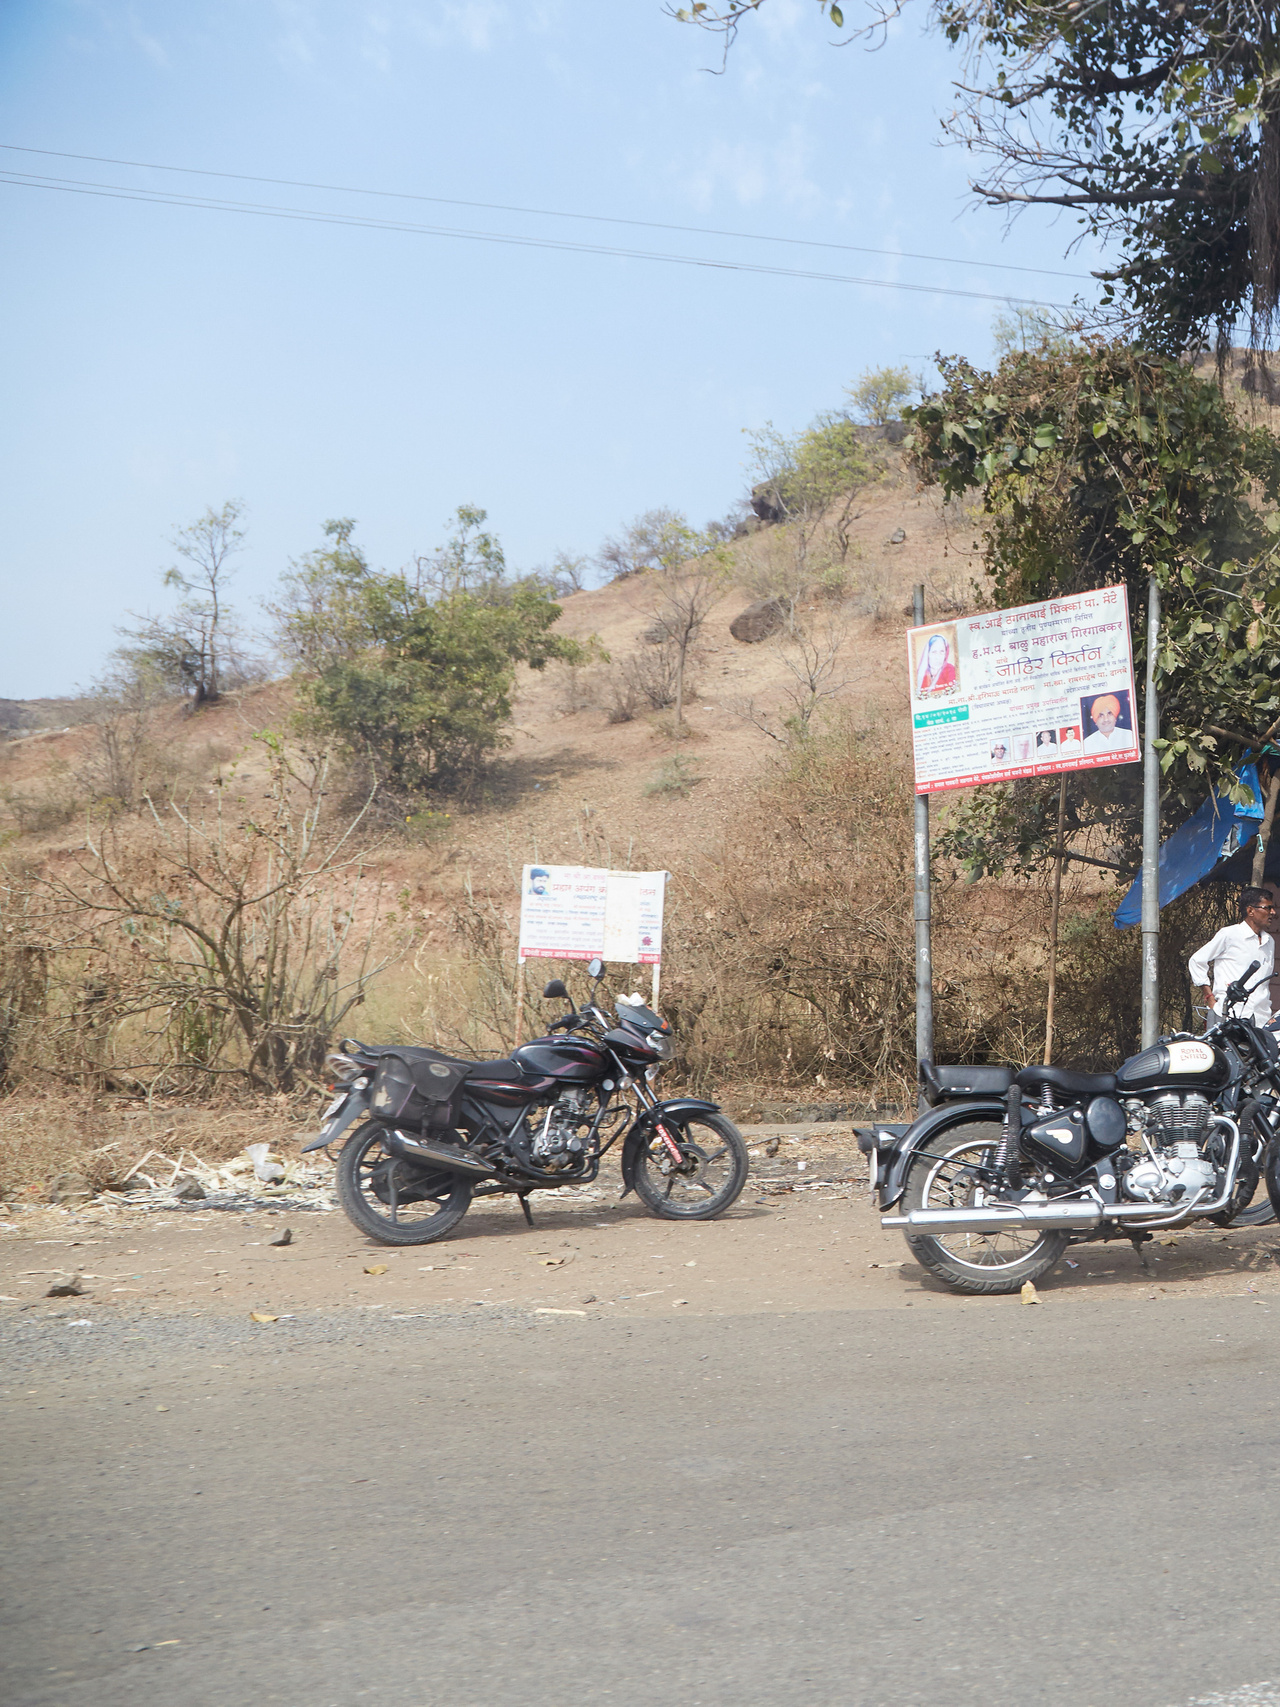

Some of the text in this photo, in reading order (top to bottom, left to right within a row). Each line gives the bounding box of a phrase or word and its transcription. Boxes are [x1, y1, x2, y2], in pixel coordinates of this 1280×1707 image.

[1031, 632, 1067, 647] महाराज
[996, 656, 1045, 678] जाहिर
[1050, 645, 1103, 668] किर्तन
